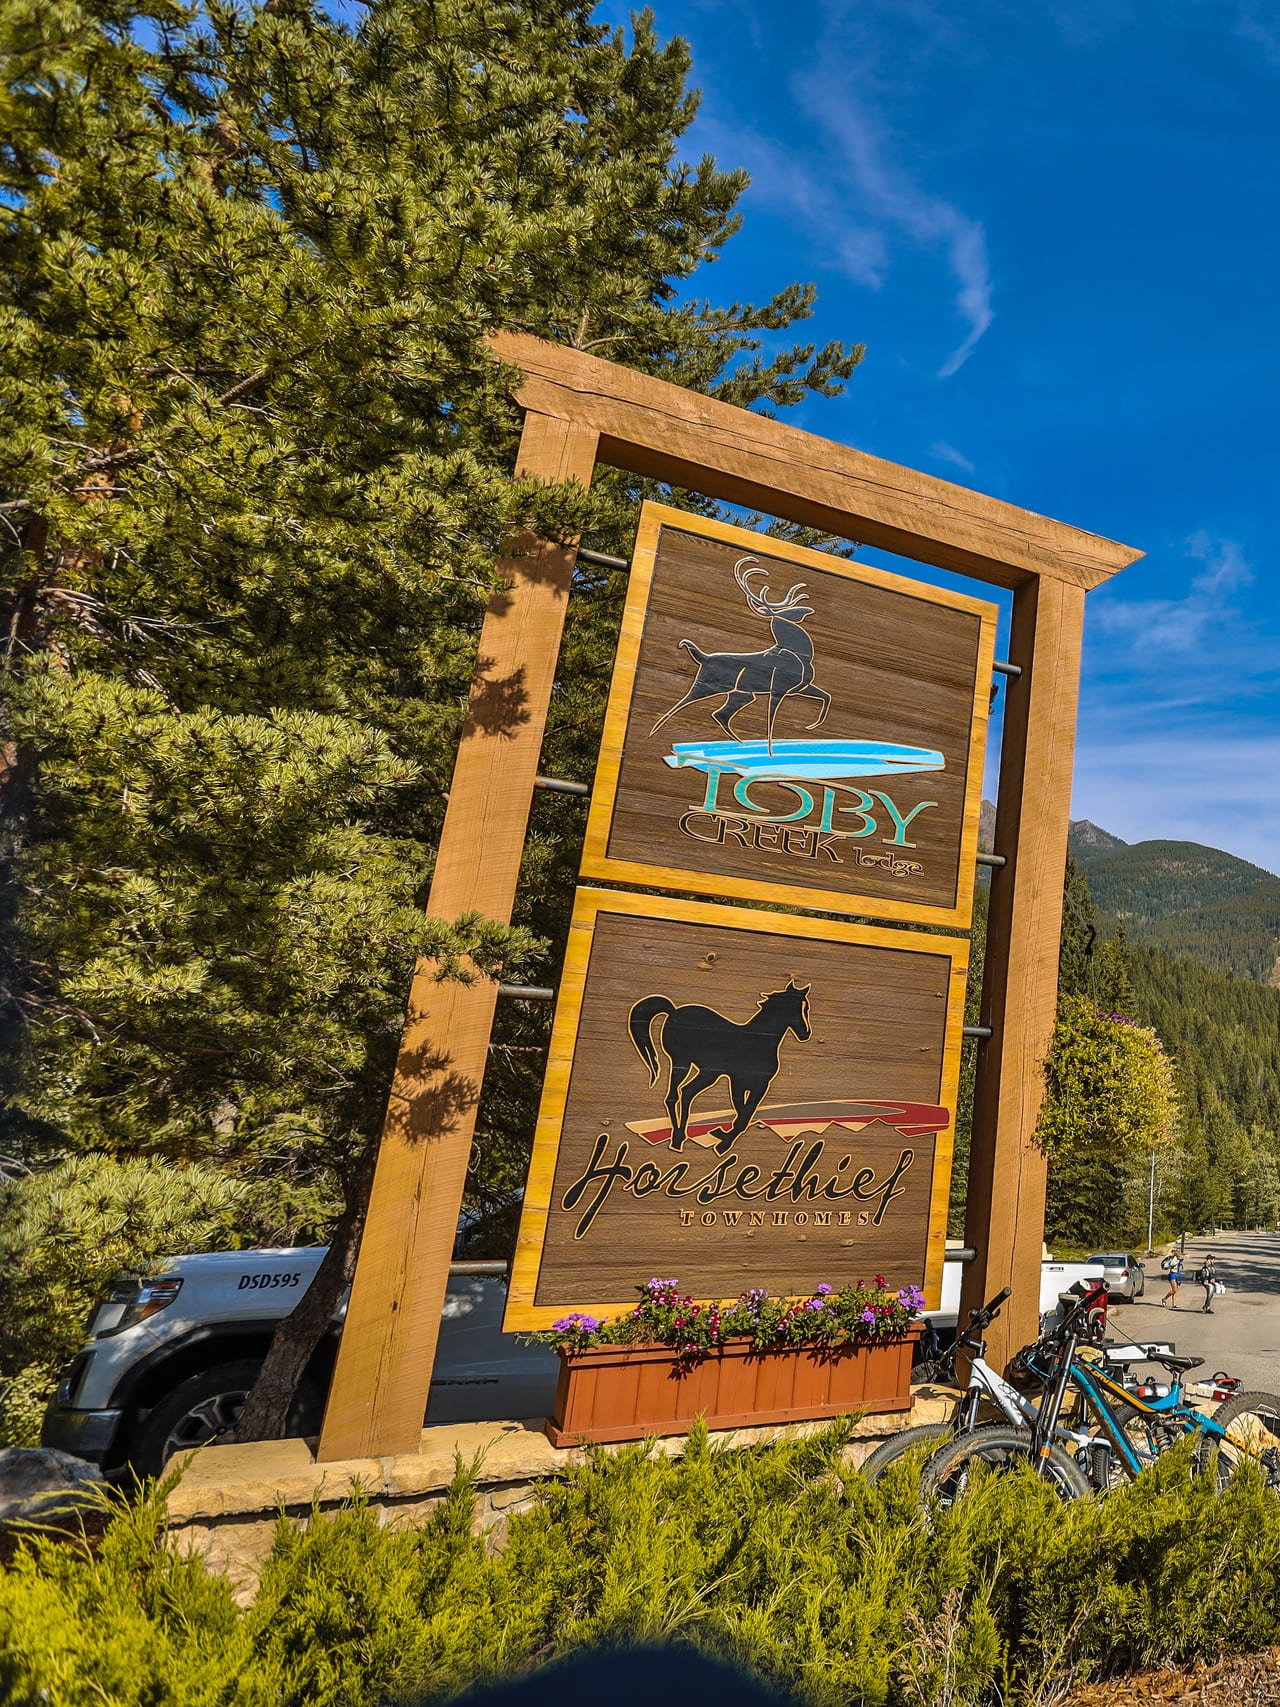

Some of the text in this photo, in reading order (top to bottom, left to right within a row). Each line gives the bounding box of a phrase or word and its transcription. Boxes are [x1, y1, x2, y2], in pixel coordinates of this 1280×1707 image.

[676, 753, 938, 848] TOBY
[678, 810, 925, 877] CREEK lodge
[562, 1133, 915, 1240] Horsethief
[680, 1209, 869, 1226] TOWNHOMES
[237, 1273, 302, 1290] DSD595
